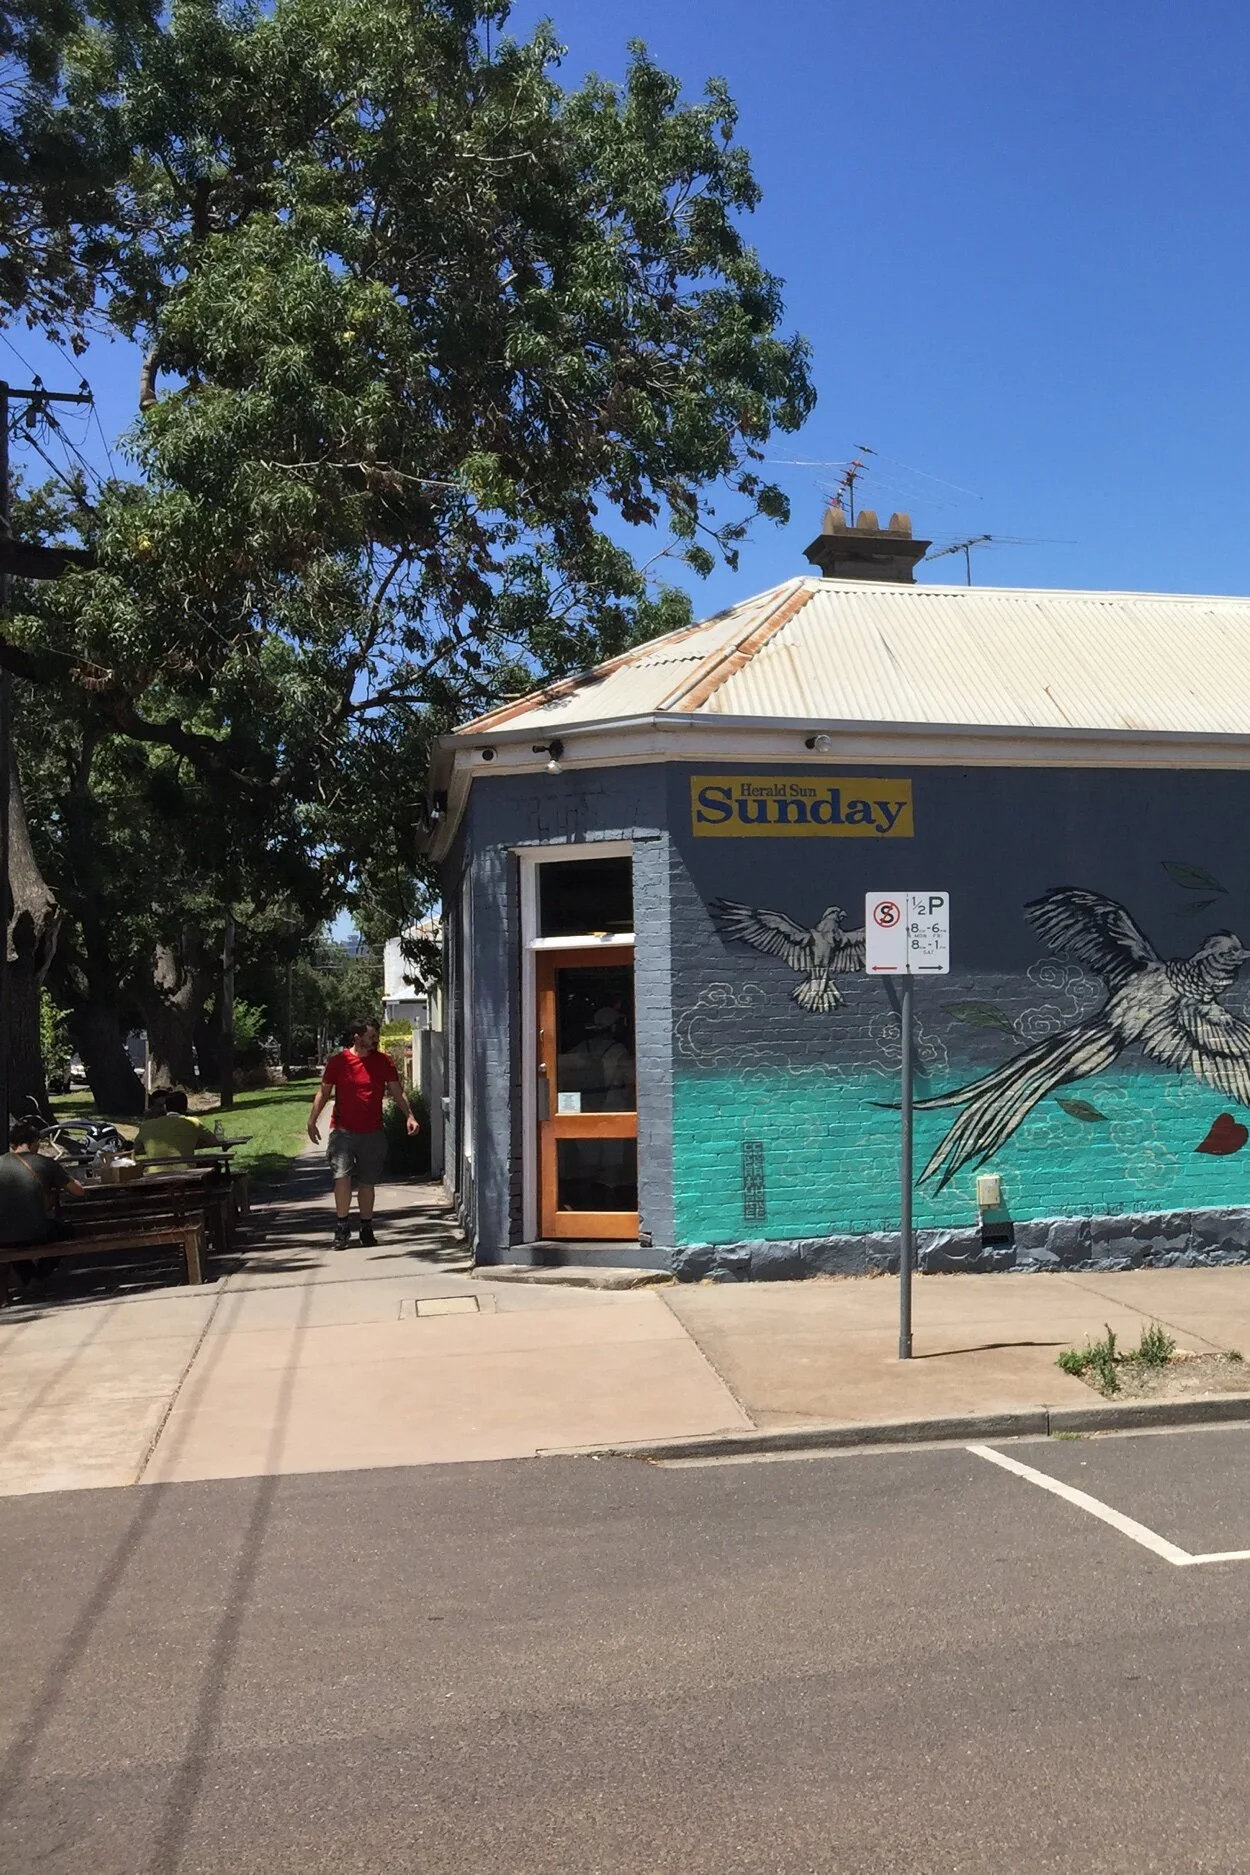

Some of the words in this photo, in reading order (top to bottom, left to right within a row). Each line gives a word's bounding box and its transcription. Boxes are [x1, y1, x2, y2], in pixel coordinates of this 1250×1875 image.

[740, 783, 787, 797] Herald
[789, 784, 817, 797] Sun
[696, 786, 908, 833] Sunday
